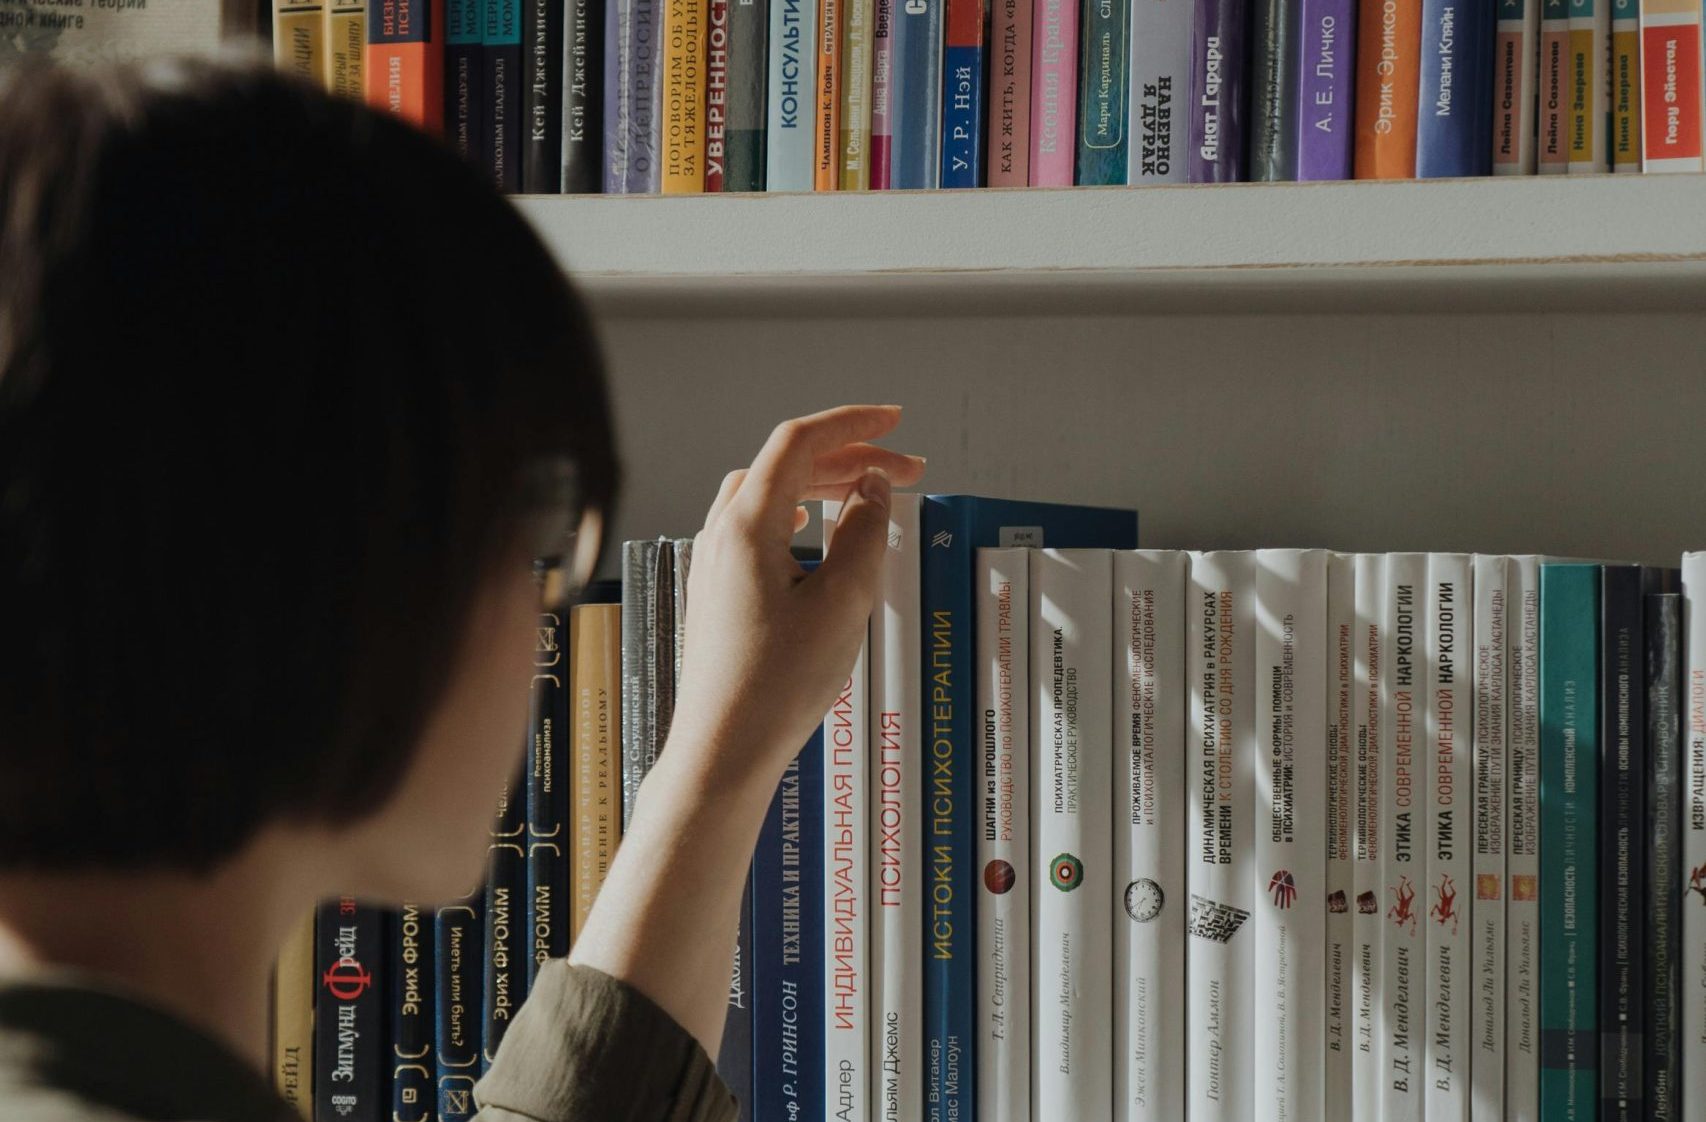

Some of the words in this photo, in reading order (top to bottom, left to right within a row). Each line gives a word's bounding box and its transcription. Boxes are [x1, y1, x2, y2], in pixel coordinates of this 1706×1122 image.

[672, 26, 682, 48] ОБ
[1004, 24, 1016, 76] КОГДА
[1317, 16, 1336, 79] Личко
[1438, 6, 1454, 53] Кляйн
[495, 58, 505, 120] ГЛАДУЭЛЛ
[634, 0, 651, 146] ДЕПРЕССИ
[954, 66, 971, 110] Нэй
[1099, 32, 1111, 98] Кардиналь
[1202, 36, 1222, 106] Гарари
[1316, 86, 1333, 104] Е.
[1436, 57, 1452, 116] Мелани
[1502, 41, 1514, 109] Сазонтова
[1548, 41, 1559, 109] Сазонтова
[1574, 52, 1586, 110] Зверева
[1619, 54, 1630, 112] Зверева
[532, 105, 545, 140] Кей
[571, 105, 584, 141] Кей
[669, 56, 682, 176] ПОГОВОРИМ
[1003, 82, 1015, 136] ЖИТЬ,
[1098, 102, 1110, 136] Мари
[1158, 76, 1171, 175] НАВЕРНО
[1200, 113, 1218, 160] Анат
[1316, 112, 1332, 132] А.
[1374, 82, 1396, 134] Эрик
[1501, 114, 1512, 154] Лейла
[1547, 114, 1558, 154] Лейла
[1574, 116, 1584, 150] Нина
[1619, 118, 1630, 151] Нина
[1664, 106, 1680, 144] Гюру
[684, 154, 695, 176] ЗА
[1002, 142, 1012, 172] КАК
[1141, 104, 1155, 176] ДУРАК
[999, 581, 1011, 632] ТРАВМЫ
[1144, 590, 1156, 677] ИССЛЕДОВАНИЯ
[1204, 592, 1216, 658] РАКУРСАХ
[1220, 591, 1234, 664] РОЖДЕНИЯ
[1396, 585, 1412, 686] НАРКОЛОГИИ
[1438, 582, 1454, 684] НАРКОЛОГИИ
[1492, 590, 1504, 652] КАСТАНЕДЫ
[1526, 590, 1538, 652] КАСТАНЕДЫ
[1054, 626, 1064, 709] ПРОПЕДЕВТИКА.
[1132, 590, 1142, 710] ФЕНОМЕНОЛОГИЧЕСКИЕ
[1284, 614, 1294, 702] СОВРЕМЕННОСТЬ
[1340, 624, 1350, 681] ПСИХИАТРИИ
[1368, 624, 1378, 681] ПСИХИАТРИИ
[1491, 653, 1502, 701] КАРЛОСА
[1525, 653, 1536, 702] КАРЛОСА
[1000, 636, 1012, 732] ПСИХОТЕРАПИИ
[1067, 668, 1078, 737] РУКОВОДСТВО
[1220, 668, 1234, 695] ДНЯ
[1220, 698, 1232, 716] СО
[1272, 666, 1283, 713] ПОМОЩИ
[1478, 644, 1489, 744] ПСИХОЛОГИЧЕСКОЕ
[1512, 645, 1522, 744] ПСИХОЛОГИЧЕСКОЕ
[1564, 680, 1576, 726] АНАЛИЗ
[1618, 674, 1630, 736] КОМПЛЕКСНОГО
[599, 688, 608, 788] РЕАЛЬНОМУ
[629, 675, 643, 762] Смулянский
[932, 610, 953, 834] ПСИХОТЕРАПИИ
[985, 710, 996, 777] ПРОШЛОГО
[1132, 712, 1142, 746] ВРЕМЯ
[1203, 673, 1215, 756] ПСИХИАТРИЯ
[1272, 714, 1282, 756] ФОРМЫ
[1284, 714, 1294, 762] ИСТОРИЯ
[1328, 724, 1338, 760] ОСНОВЫ
[1339, 690, 1350, 753] ДИАГНОСТИКИ
[1358, 724, 1367, 760] ОСНОВЫ
[1368, 690, 1379, 753] ДИАГНОСТИКИ
[1490, 704, 1502, 746] ЗНАНИЯ
[1525, 704, 1536, 746] ЗНАНИЯ
[544, 718, 552, 792] психоанализа
[582, 688, 591, 806] ЧЕРНОГЛАЗОВ
[1054, 712, 1064, 813] ПСИХИАТРИЧЕСКАЯ
[1067, 739, 1077, 813] ПРАКТИЧЕСКОЕ
[1220, 719, 1232, 789] СТОЛЕТИЮ
[1394, 691, 1412, 807] СОВРЕМЕННОЙ
[1436, 688, 1453, 806] СОВРЕМЕННОЙ
[1478, 746, 1490, 794] ГРАНИЦУ:
[1490, 748, 1502, 775] ПУТИ
[1512, 746, 1524, 794] ГРАНИЦУ:
[1525, 748, 1536, 776] ПУТИ
[1562, 728, 1576, 794] КОМПЛЕКСНЫЙ
[1618, 738, 1629, 770] ОСНОВЫ
[881, 712, 901, 906] ПСИХОЛОГИЯ
[1000, 753, 1014, 840] РУКОВОДСТВО
[1132, 750, 1142, 824] ПРОЖИВАЕМОЕ
[1203, 760, 1217, 864] ДИНАМИЧЕСКАЯ
[1272, 758, 1284, 842] ОБЩЕСТВЕННЫЕ
[1284, 764, 1294, 834] ПСИХИАТРИИ:
[1328, 764, 1337, 860] ТЕРМИНОЛОГИЧЕСКИЕ
[1339, 756, 1349, 860] ФЕНОМЕНОЛОГИЧЕСКОЙ
[1358, 764, 1367, 860] ТЕРМИНОЛОГИЧЕСКИЕ
[1368, 756, 1378, 860] ФЕНОМЕНОЛОГИЧЕСКОЙ
[1490, 777, 1502, 854] ИЗОБРАЖЕНИЕ
[1525, 778, 1536, 855] ИЗОБРАЖЕНИЕ
[782, 775, 801, 866] ПРАКТИКА
[986, 798, 996, 840] ШАГНИ
[1220, 805, 1232, 864] ВРЕМЕНИ
[1396, 812, 1411, 862] ЭТИКА
[1438, 811, 1452, 860] ЭТИКА
[1478, 796, 1489, 854] ПЕРЕСЕКАЯ
[1512, 796, 1523, 855] ПЕРЕСЕКАЯ
[1618, 827, 1629, 886] БЕЗОПАСНОСТЬ
[494, 888, 510, 968] ФРОММ
[536, 886, 552, 965] ФРОММ
[784, 886, 801, 965] ТЕХНИКА
[834, 775, 857, 1030] ИНДИВИДУАЛЬНАЯ
[933, 846, 953, 960] ИСТОКИ
[1564, 866, 1576, 929] БЕЗОПАСНОСТЬ
[322, 926, 372, 1000] Фрейд
[450, 926, 463, 971] Иметь
[992, 918, 1007, 1006] Свиридкина
[1060, 932, 1070, 1006] Менделевич
[1484, 920, 1495, 974] Уильямс
[1520, 920, 1530, 976] Уильямс
[402, 968, 422, 1016] Эрих
[451, 975, 461, 1002] или
[494, 972, 512, 1020] Эрих
[1207, 980, 1220, 1036] Аммон
[1330, 943, 1341, 1018] Менделевич
[1360, 944, 1370, 1020] Менделевич
[1394, 947, 1409, 1050] Менделевич
[1436, 946, 1450, 1048] Менделевич
[331, 1006, 360, 1082] Зигмунд
[450, 1006, 464, 1046] быть?
[782, 980, 798, 1076] ГРИНСОН
[884, 1012, 901, 1074] Джемс
[1060, 1010, 1072, 1074] Владимир
[1134, 976, 1147, 1064] Минковский
[1483, 996, 1494, 1052] Дональд
[1519, 998, 1530, 1054] Дональд
[282, 1046, 300, 1103] РЕЙД
[836, 1060, 855, 1122] Адлер
[929, 1039, 942, 1102] Витакер
[946, 1036, 962, 1095] Малоун
[1206, 1040, 1222, 1102] Гюнтер
[1394, 1078, 1408, 1093] В.
[1436, 1054, 1452, 1072] Д.
[1436, 1076, 1450, 1092] В.
